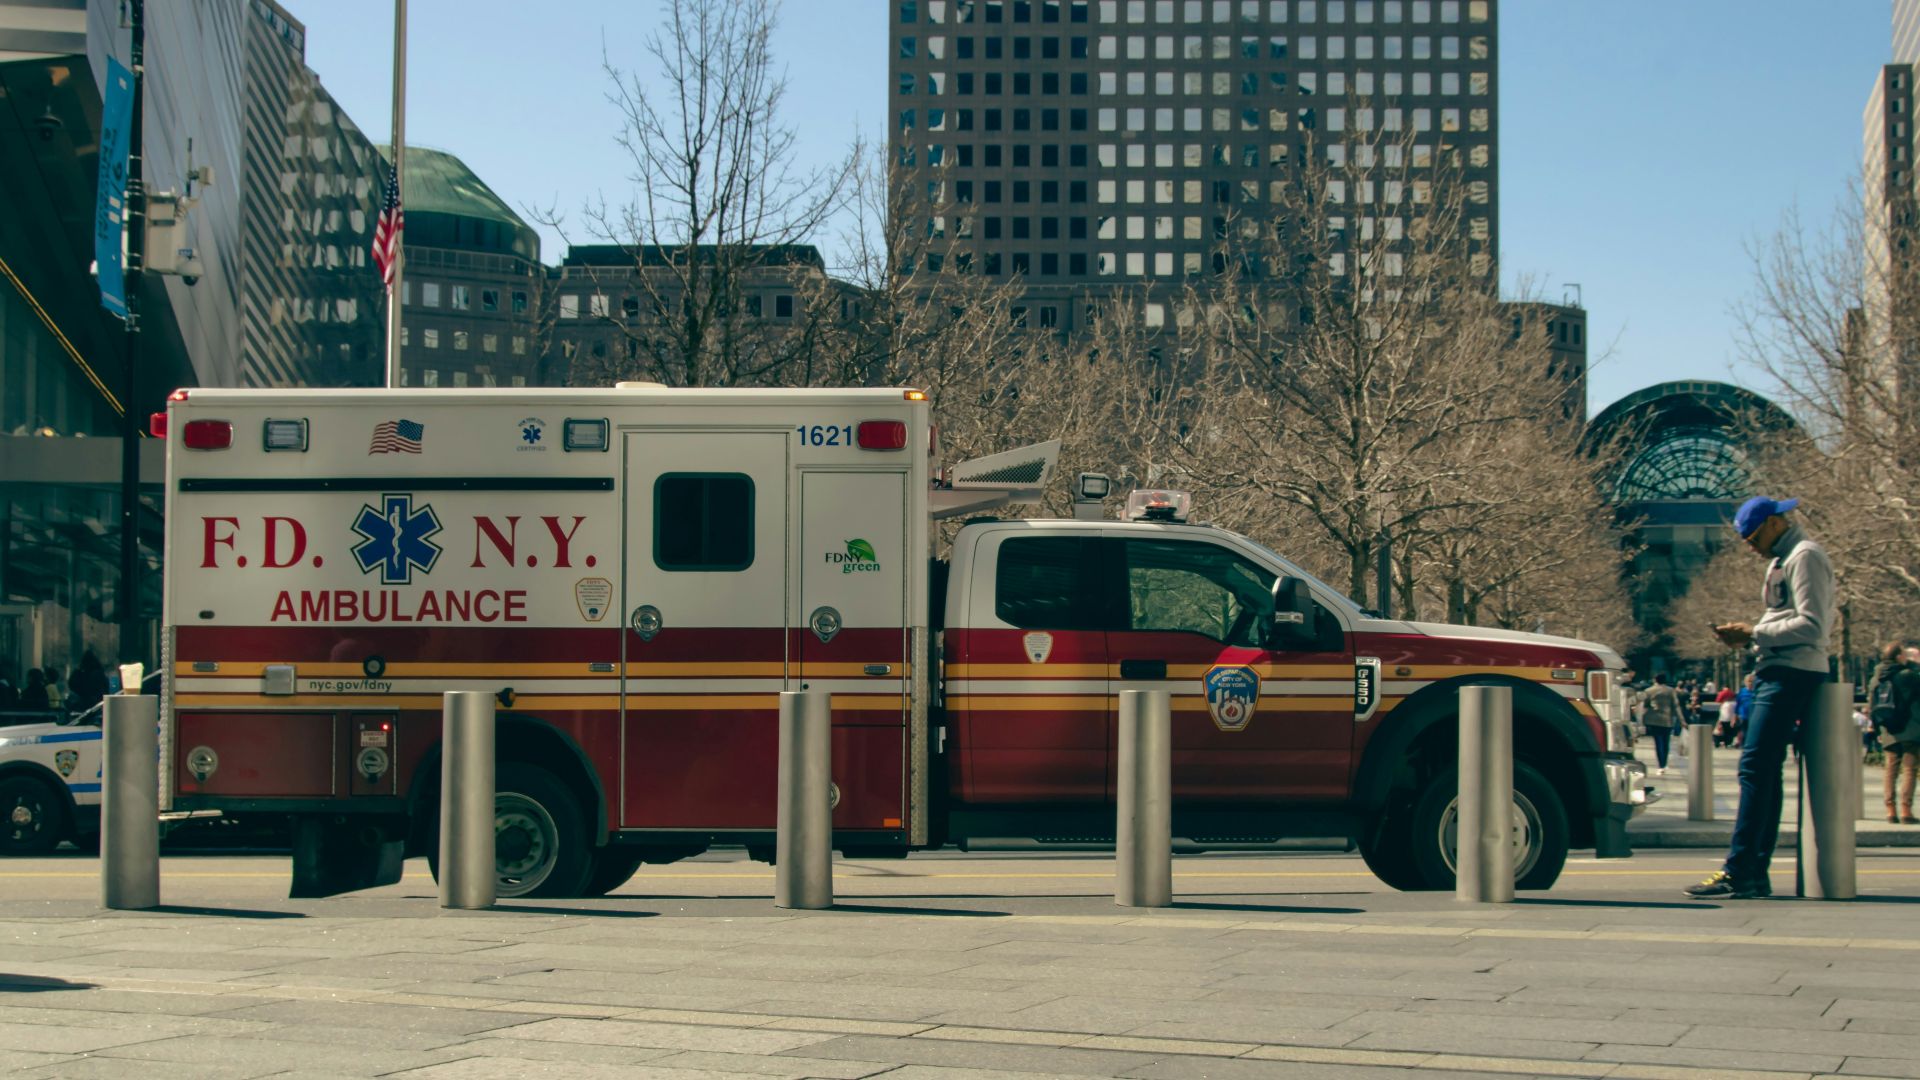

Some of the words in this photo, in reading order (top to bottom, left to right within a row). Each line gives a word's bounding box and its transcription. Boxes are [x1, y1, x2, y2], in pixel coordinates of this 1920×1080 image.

[796, 425, 852, 447] 1621
[201, 516, 323, 568] F.D.
[470, 516, 598, 568] N.Y.
[825, 552, 863, 563] FDNY
[842, 563, 881, 574] green
[271, 590, 527, 622] AMBULANCE
[309, 679, 392, 693] nyc.gov/fdny
